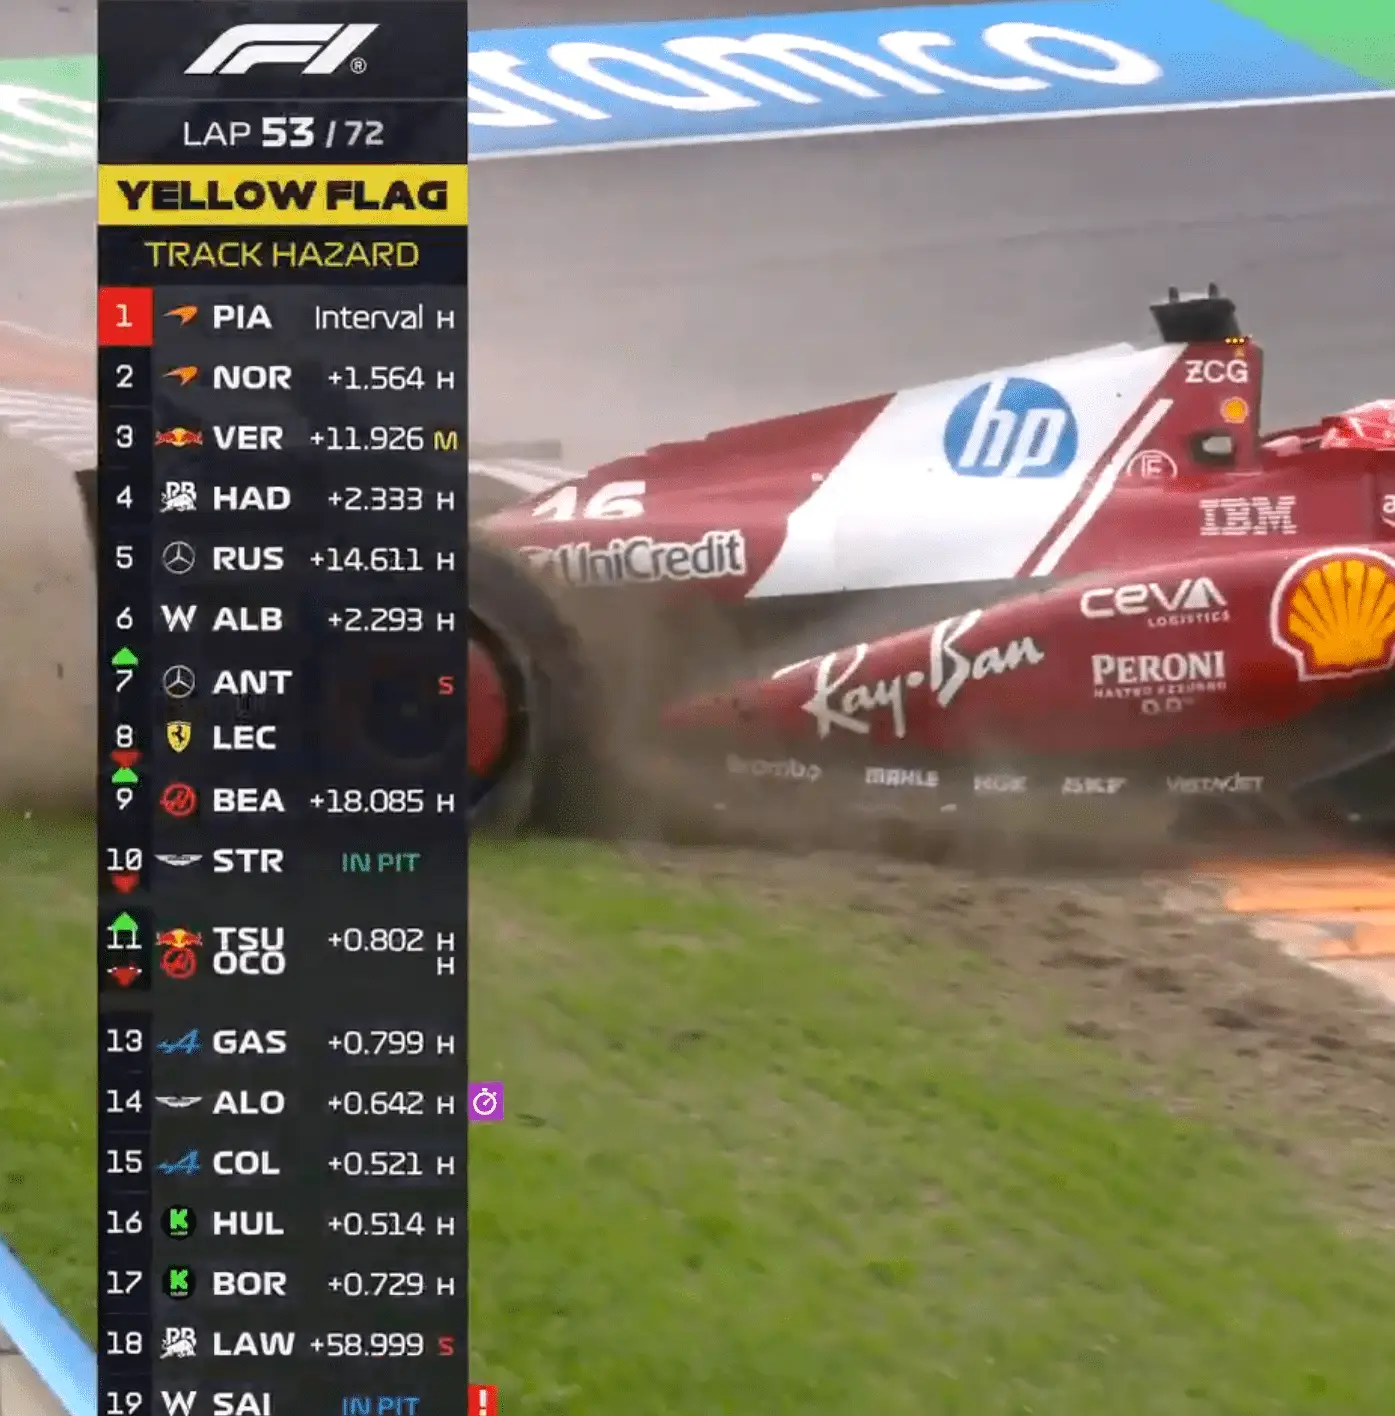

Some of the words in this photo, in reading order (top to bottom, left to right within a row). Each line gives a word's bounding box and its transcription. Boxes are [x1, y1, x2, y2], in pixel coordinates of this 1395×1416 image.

[468, 22, 1164, 128] ramco
[957, 378, 1066, 476] hp
[532, 481, 646, 521] 16
[1200, 495, 1297, 536] IBM
[558, 531, 746, 585] UniCredit
[1147, 609, 1230, 628] LOGISTICS
[1091, 650, 1225, 686] PERONI
[865, 766, 940, 788] MAHLE
